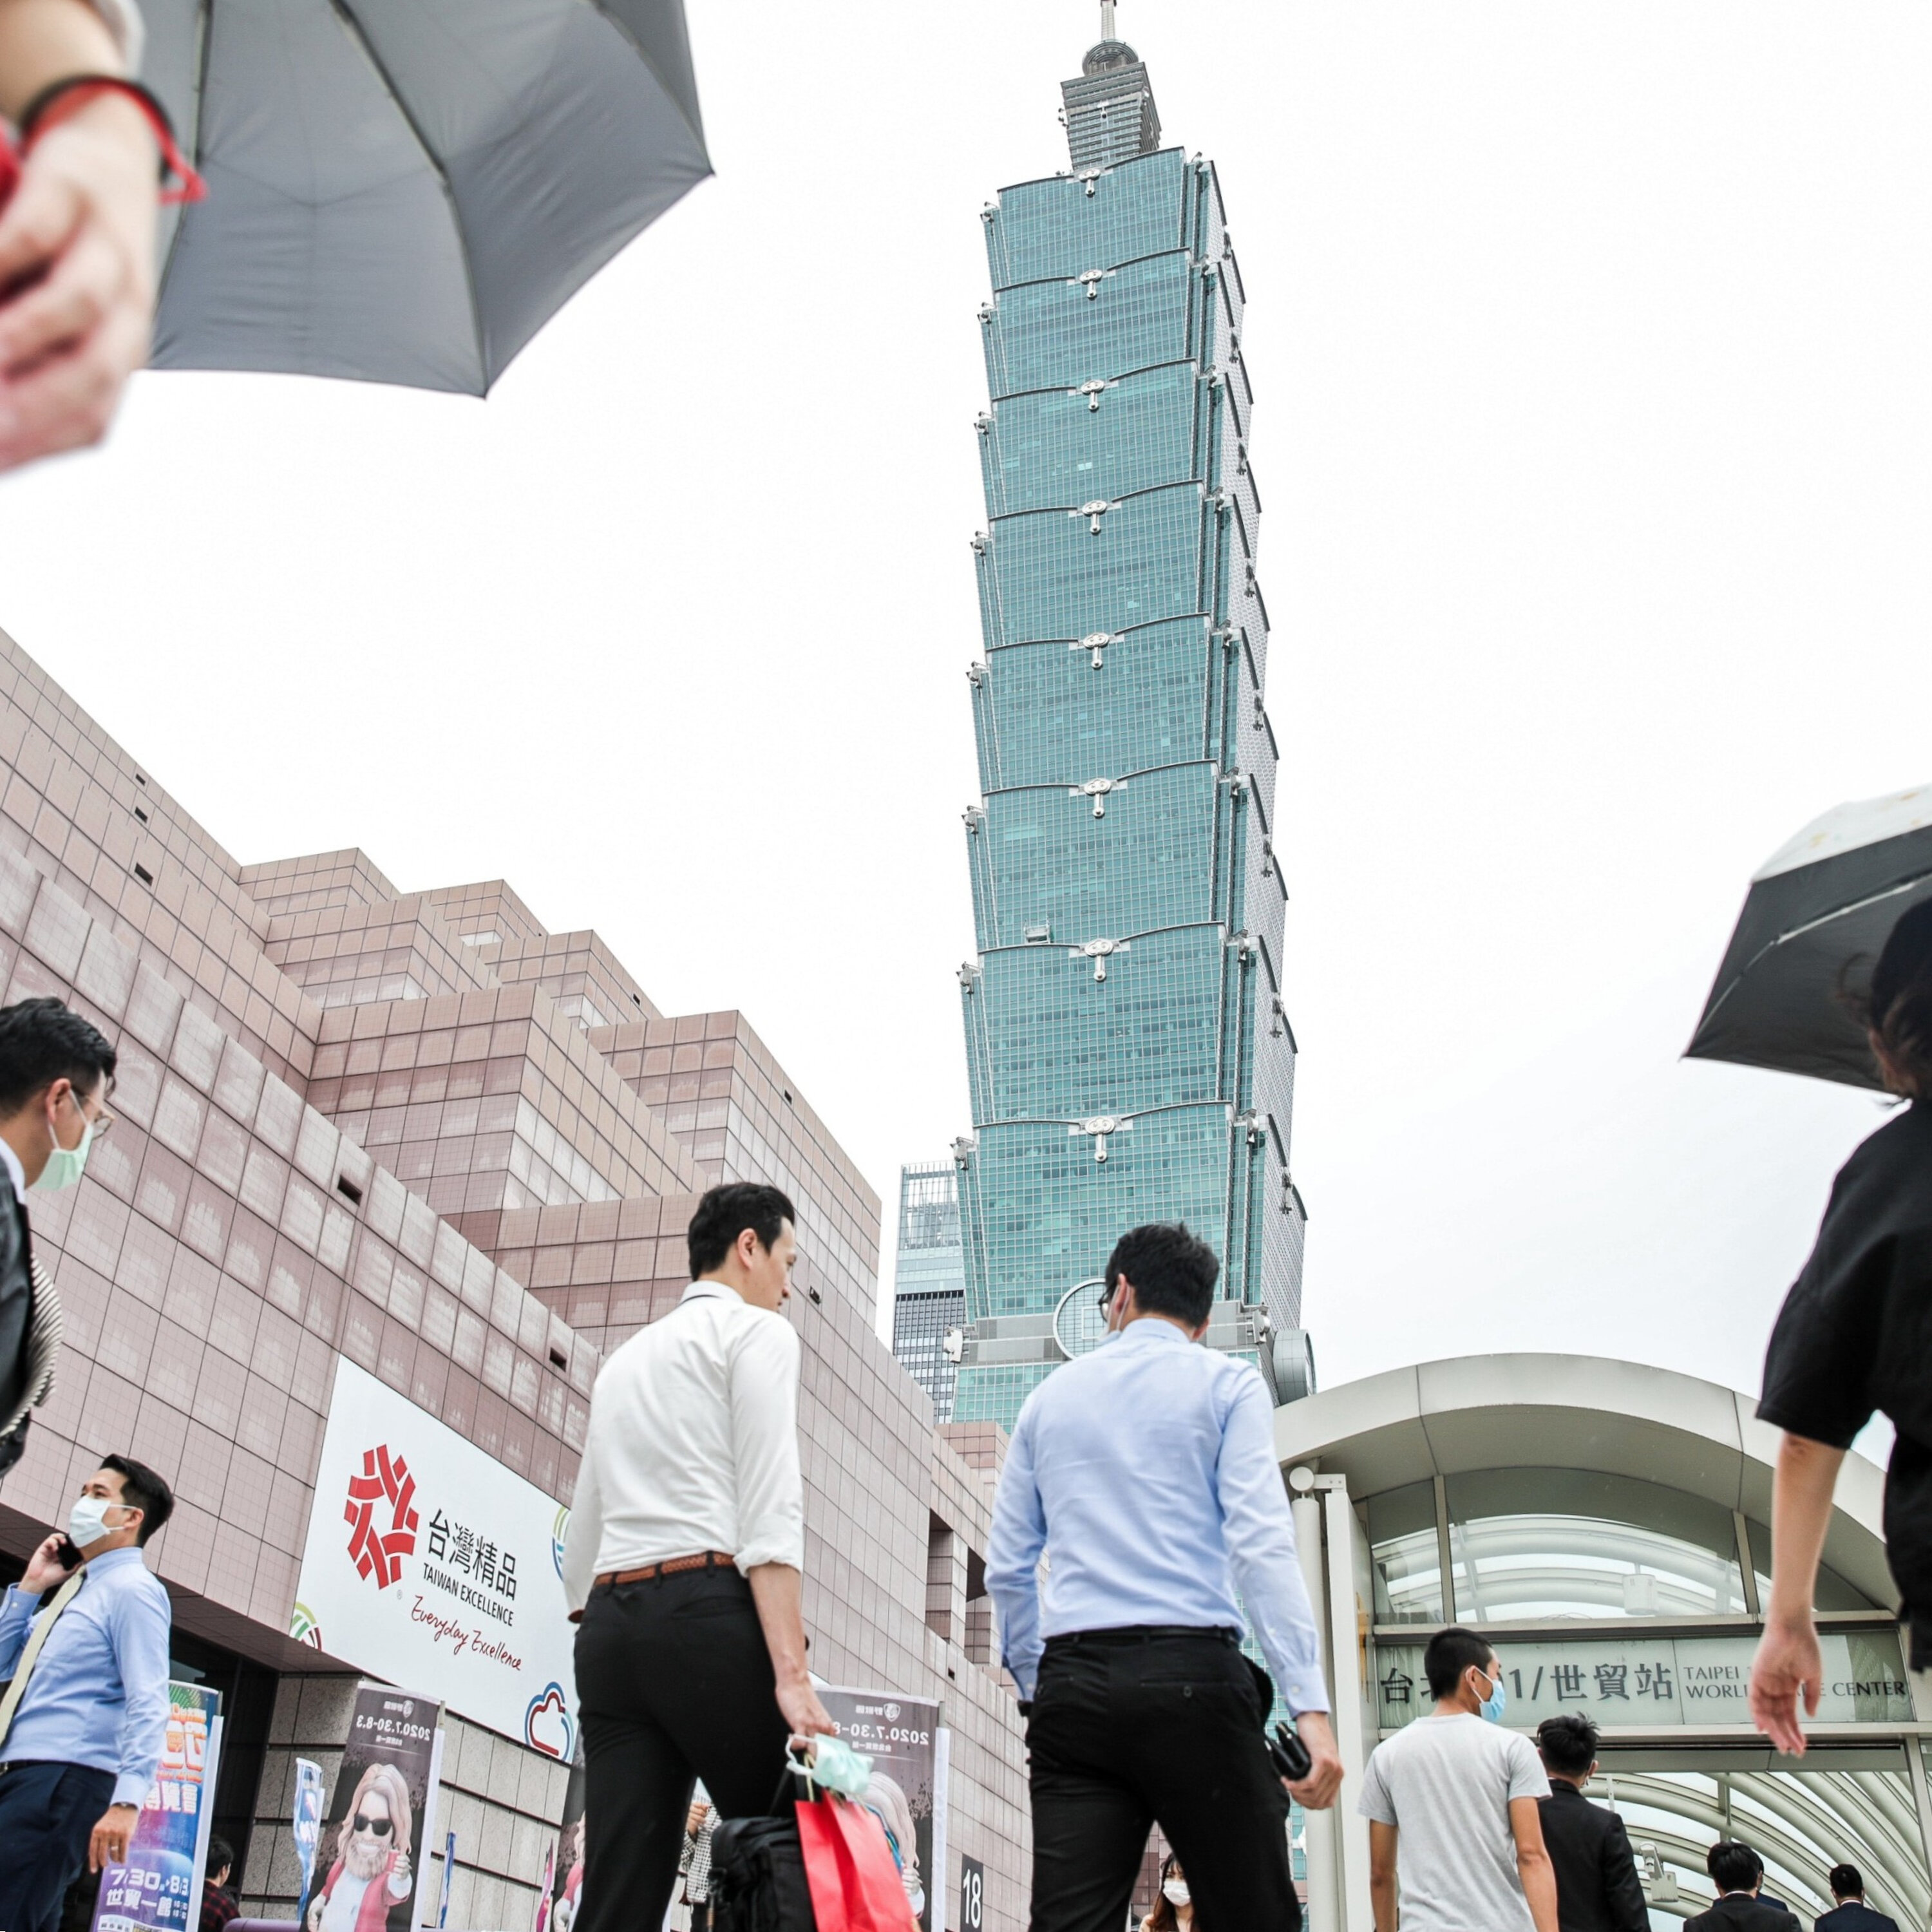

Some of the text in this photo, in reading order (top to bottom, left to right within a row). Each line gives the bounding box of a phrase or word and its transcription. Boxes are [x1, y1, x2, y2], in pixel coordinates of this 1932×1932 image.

[428, 1508, 517, 1601] 台灣精品
[424, 1562, 514, 1627] TAIWAN EXCELLENCE
[411, 1595, 522, 1671] Everyday Excellence
[1683, 1666, 1739, 1680] TAIPEI
[1832, 1680, 1907, 1696] CENTER
[963, 1868, 981, 1929] 18
